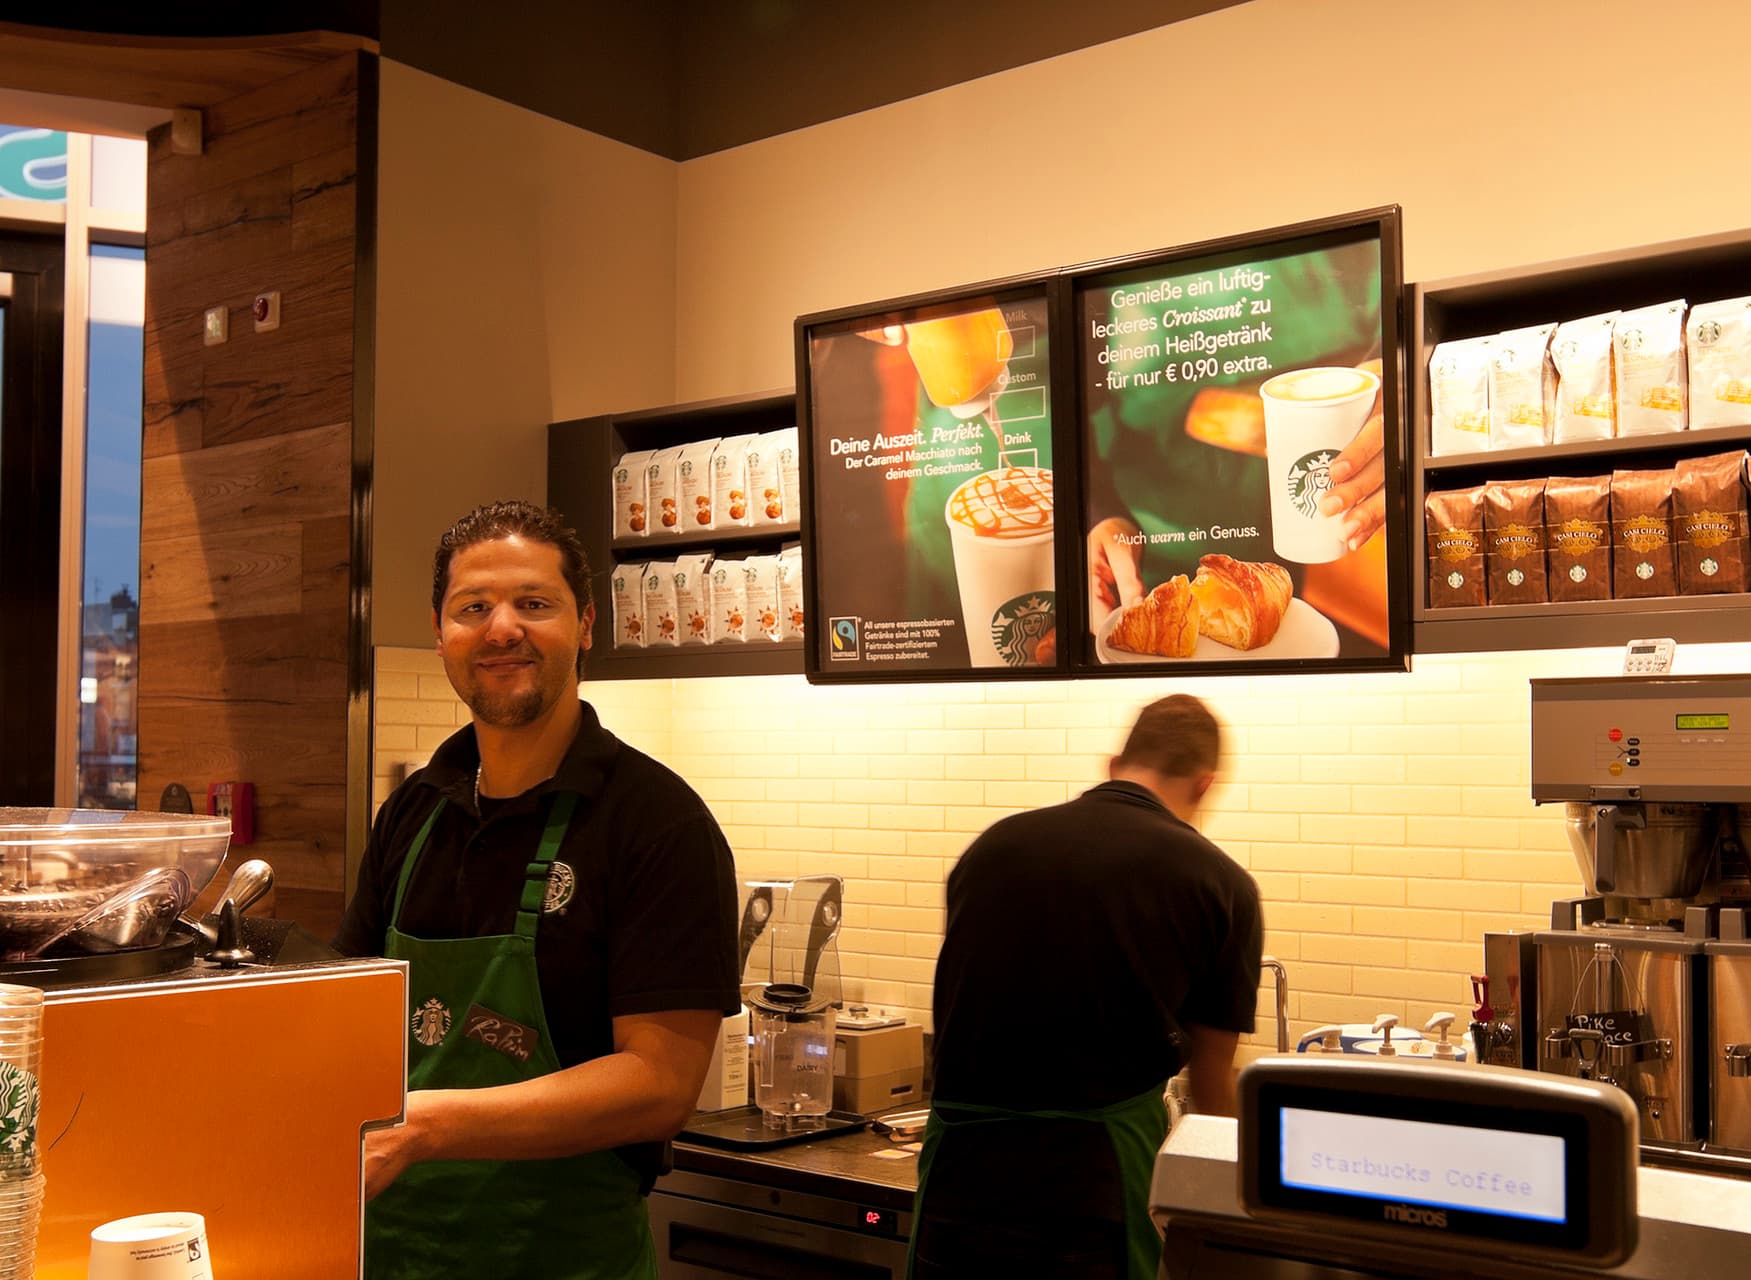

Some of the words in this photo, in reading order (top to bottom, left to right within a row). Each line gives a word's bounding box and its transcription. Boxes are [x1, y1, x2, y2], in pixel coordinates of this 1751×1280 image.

[1110, 282, 1182, 308] Genieße
[1188, 276, 1213, 296] ein
[1219, 269, 1271, 292] luftig-
[1006, 310, 1027, 322] Milk
[1092, 316, 1158, 338] leckeres
[1250, 299, 1271, 315] zu
[1098, 344, 1160, 364] deinem
[1166, 322, 1272, 356] Heißgetränk
[997, 372, 1036, 385] Custom
[1106, 370, 1130, 390] für
[1134, 370, 1162, 386] nur
[1166, 363, 1177, 382] €
[1182, 358, 1218, 382] 0,90
[1223, 355, 1272, 376] extra.
[830, 436, 870, 456] Deine
[873, 430, 926, 450] Auszeit.
[931, 422, 984, 444] Perfekt.
[1004, 432, 1032, 446] Drink
[846, 456, 863, 469] Der
[864, 452, 903, 467] Caramel
[906, 448, 956, 462] Macchiato
[958, 444, 982, 456] nach
[886, 466, 922, 480] deinem
[924, 459, 984, 476] Geschmack.
[1150, 532, 1185, 544] warm
[1188, 528, 1207, 541] ein
[1210, 525, 1260, 540] Genuss.
[864, 631, 894, 640] Getränke
[896, 630, 909, 639] sind
[910, 630, 921, 638] mit
[922, 629, 940, 638] 100%
[874, 621, 895, 630] unsere
[866, 652, 894, 662] Espresso
[1310, 1151, 1431, 1184] Starbucks
[1446, 1168, 1533, 1197] Coffee
[1384, 1203, 1448, 1229] micros
